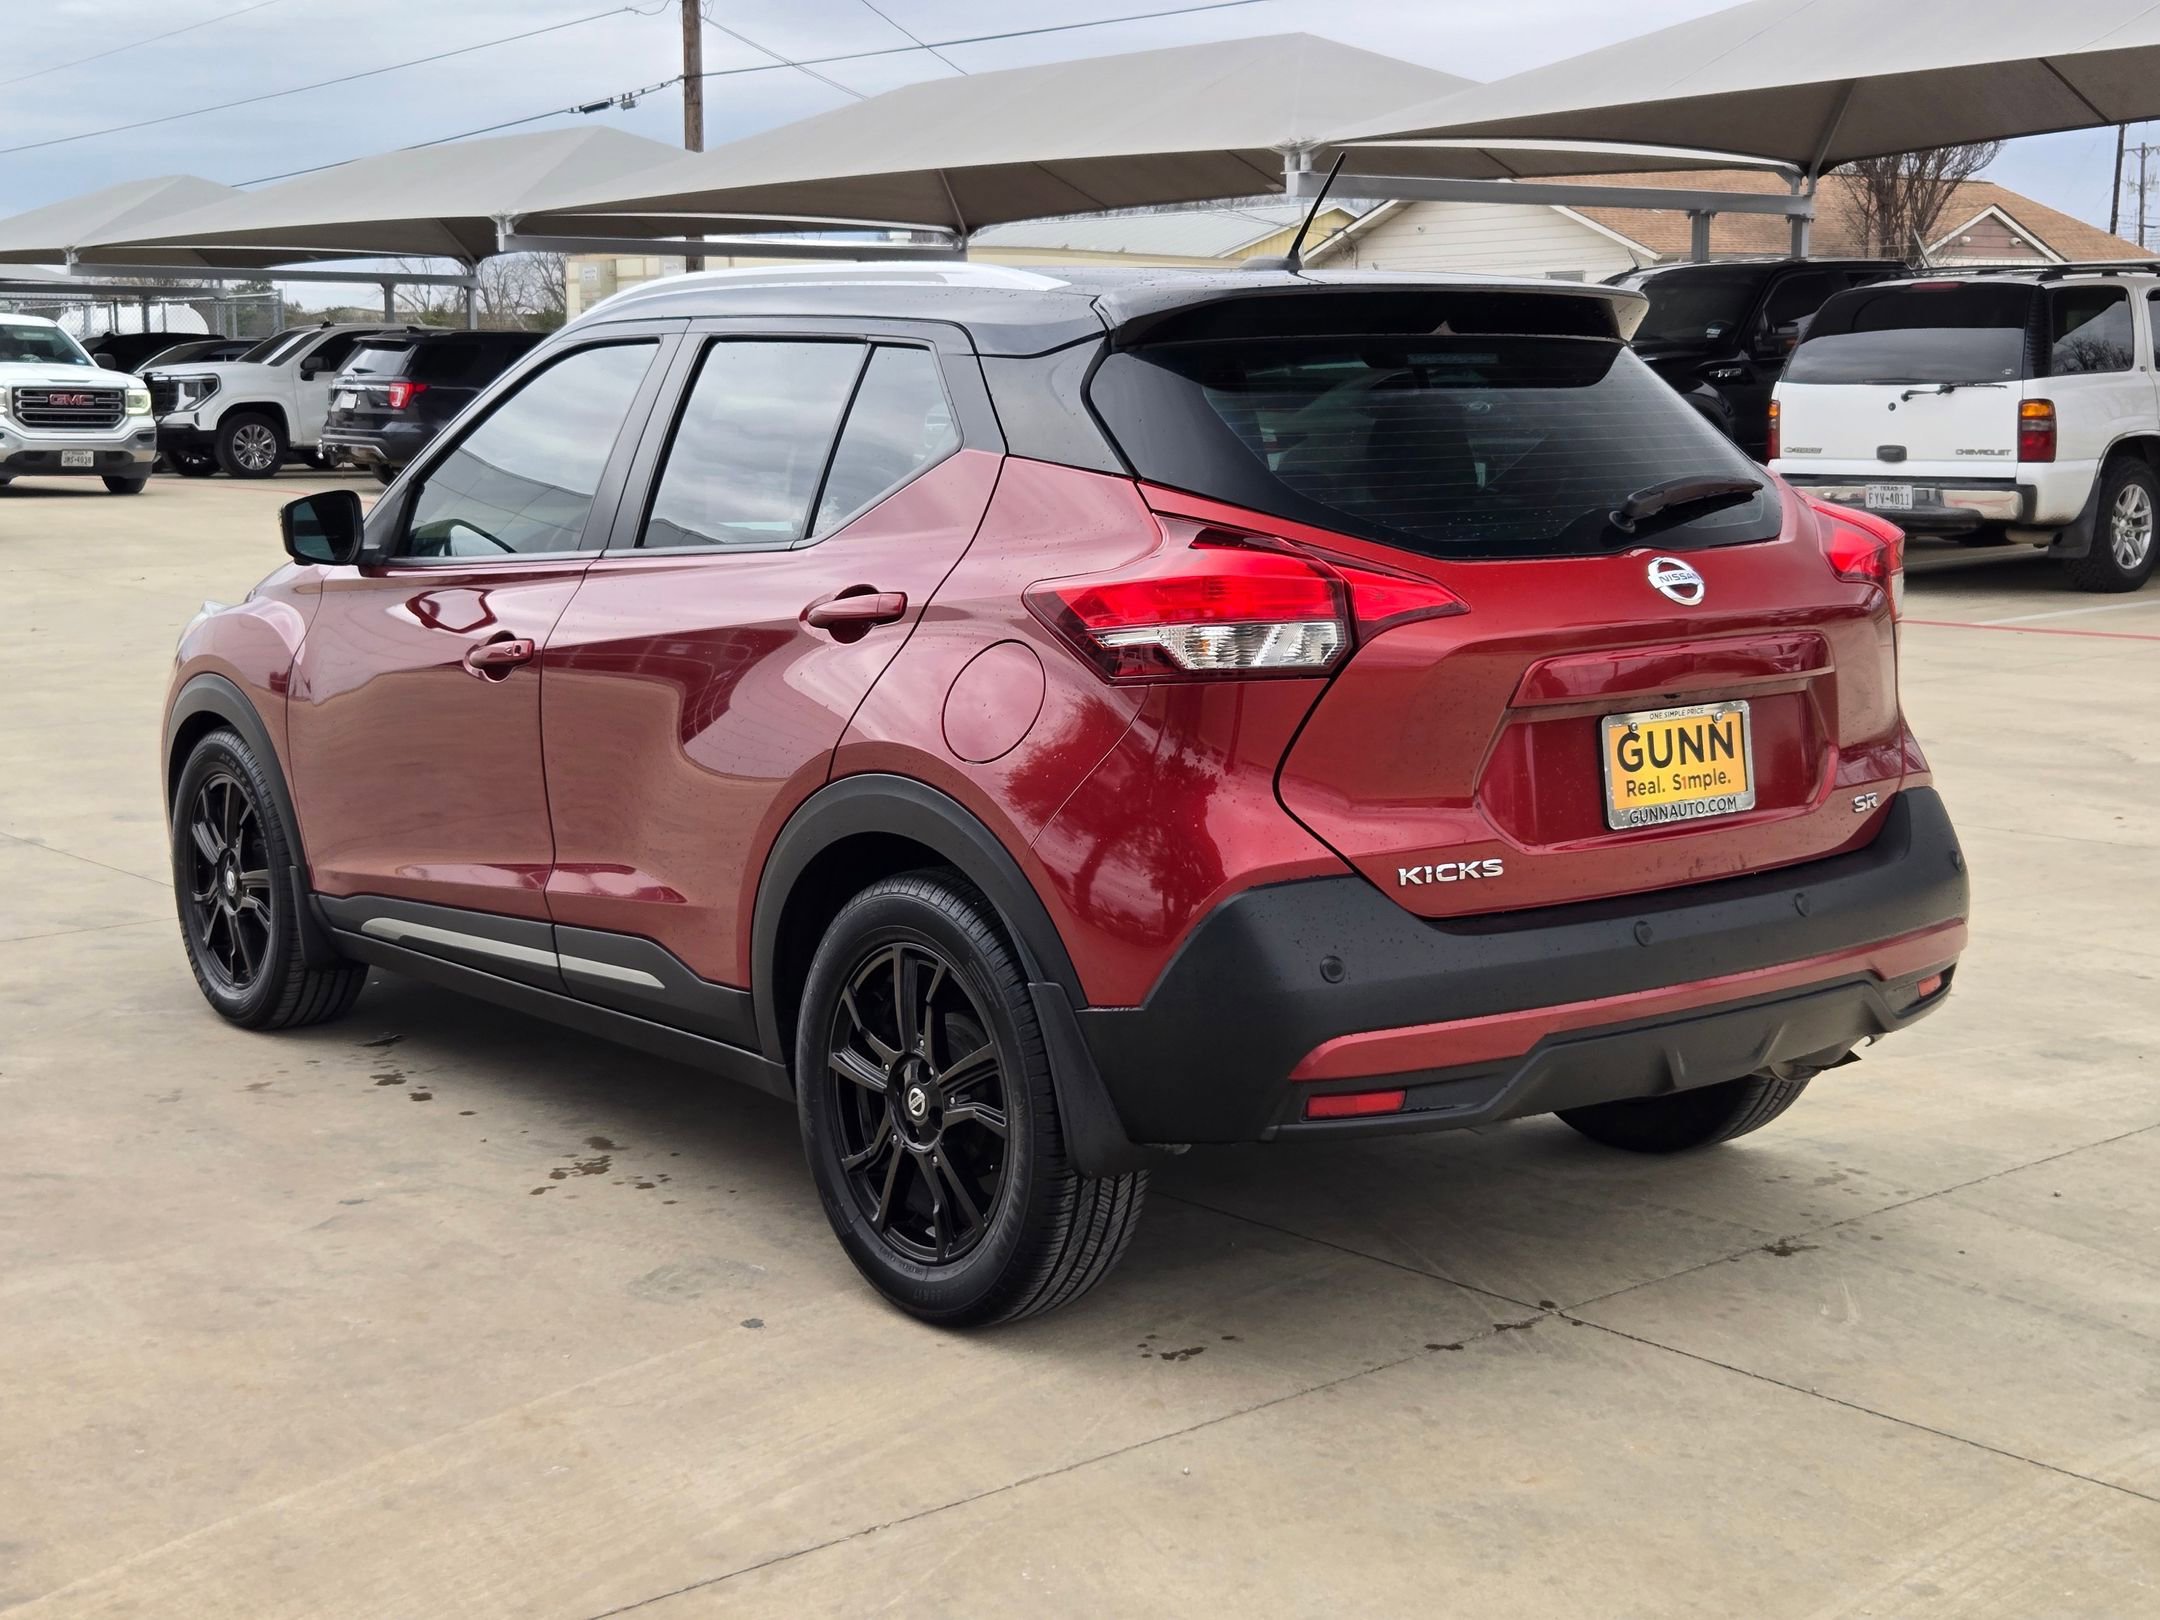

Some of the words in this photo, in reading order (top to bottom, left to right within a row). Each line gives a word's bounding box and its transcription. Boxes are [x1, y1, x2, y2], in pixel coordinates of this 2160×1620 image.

[49, 394, 95, 405] GMC
[1658, 571, 1701, 583] NISSAN
[1649, 711, 1663, 720] ONE
[1664, 709, 1686, 718] SIMPLE
[1686, 707, 1704, 716] PRICE
[1616, 721, 1735, 773] GUNN
[1626, 776, 1666, 798] Real.
[1629, 796, 1737, 825] GUNNAUTO.COM
[1854, 792, 1878, 812] SR
[1398, 859, 1504, 886] KICKS
